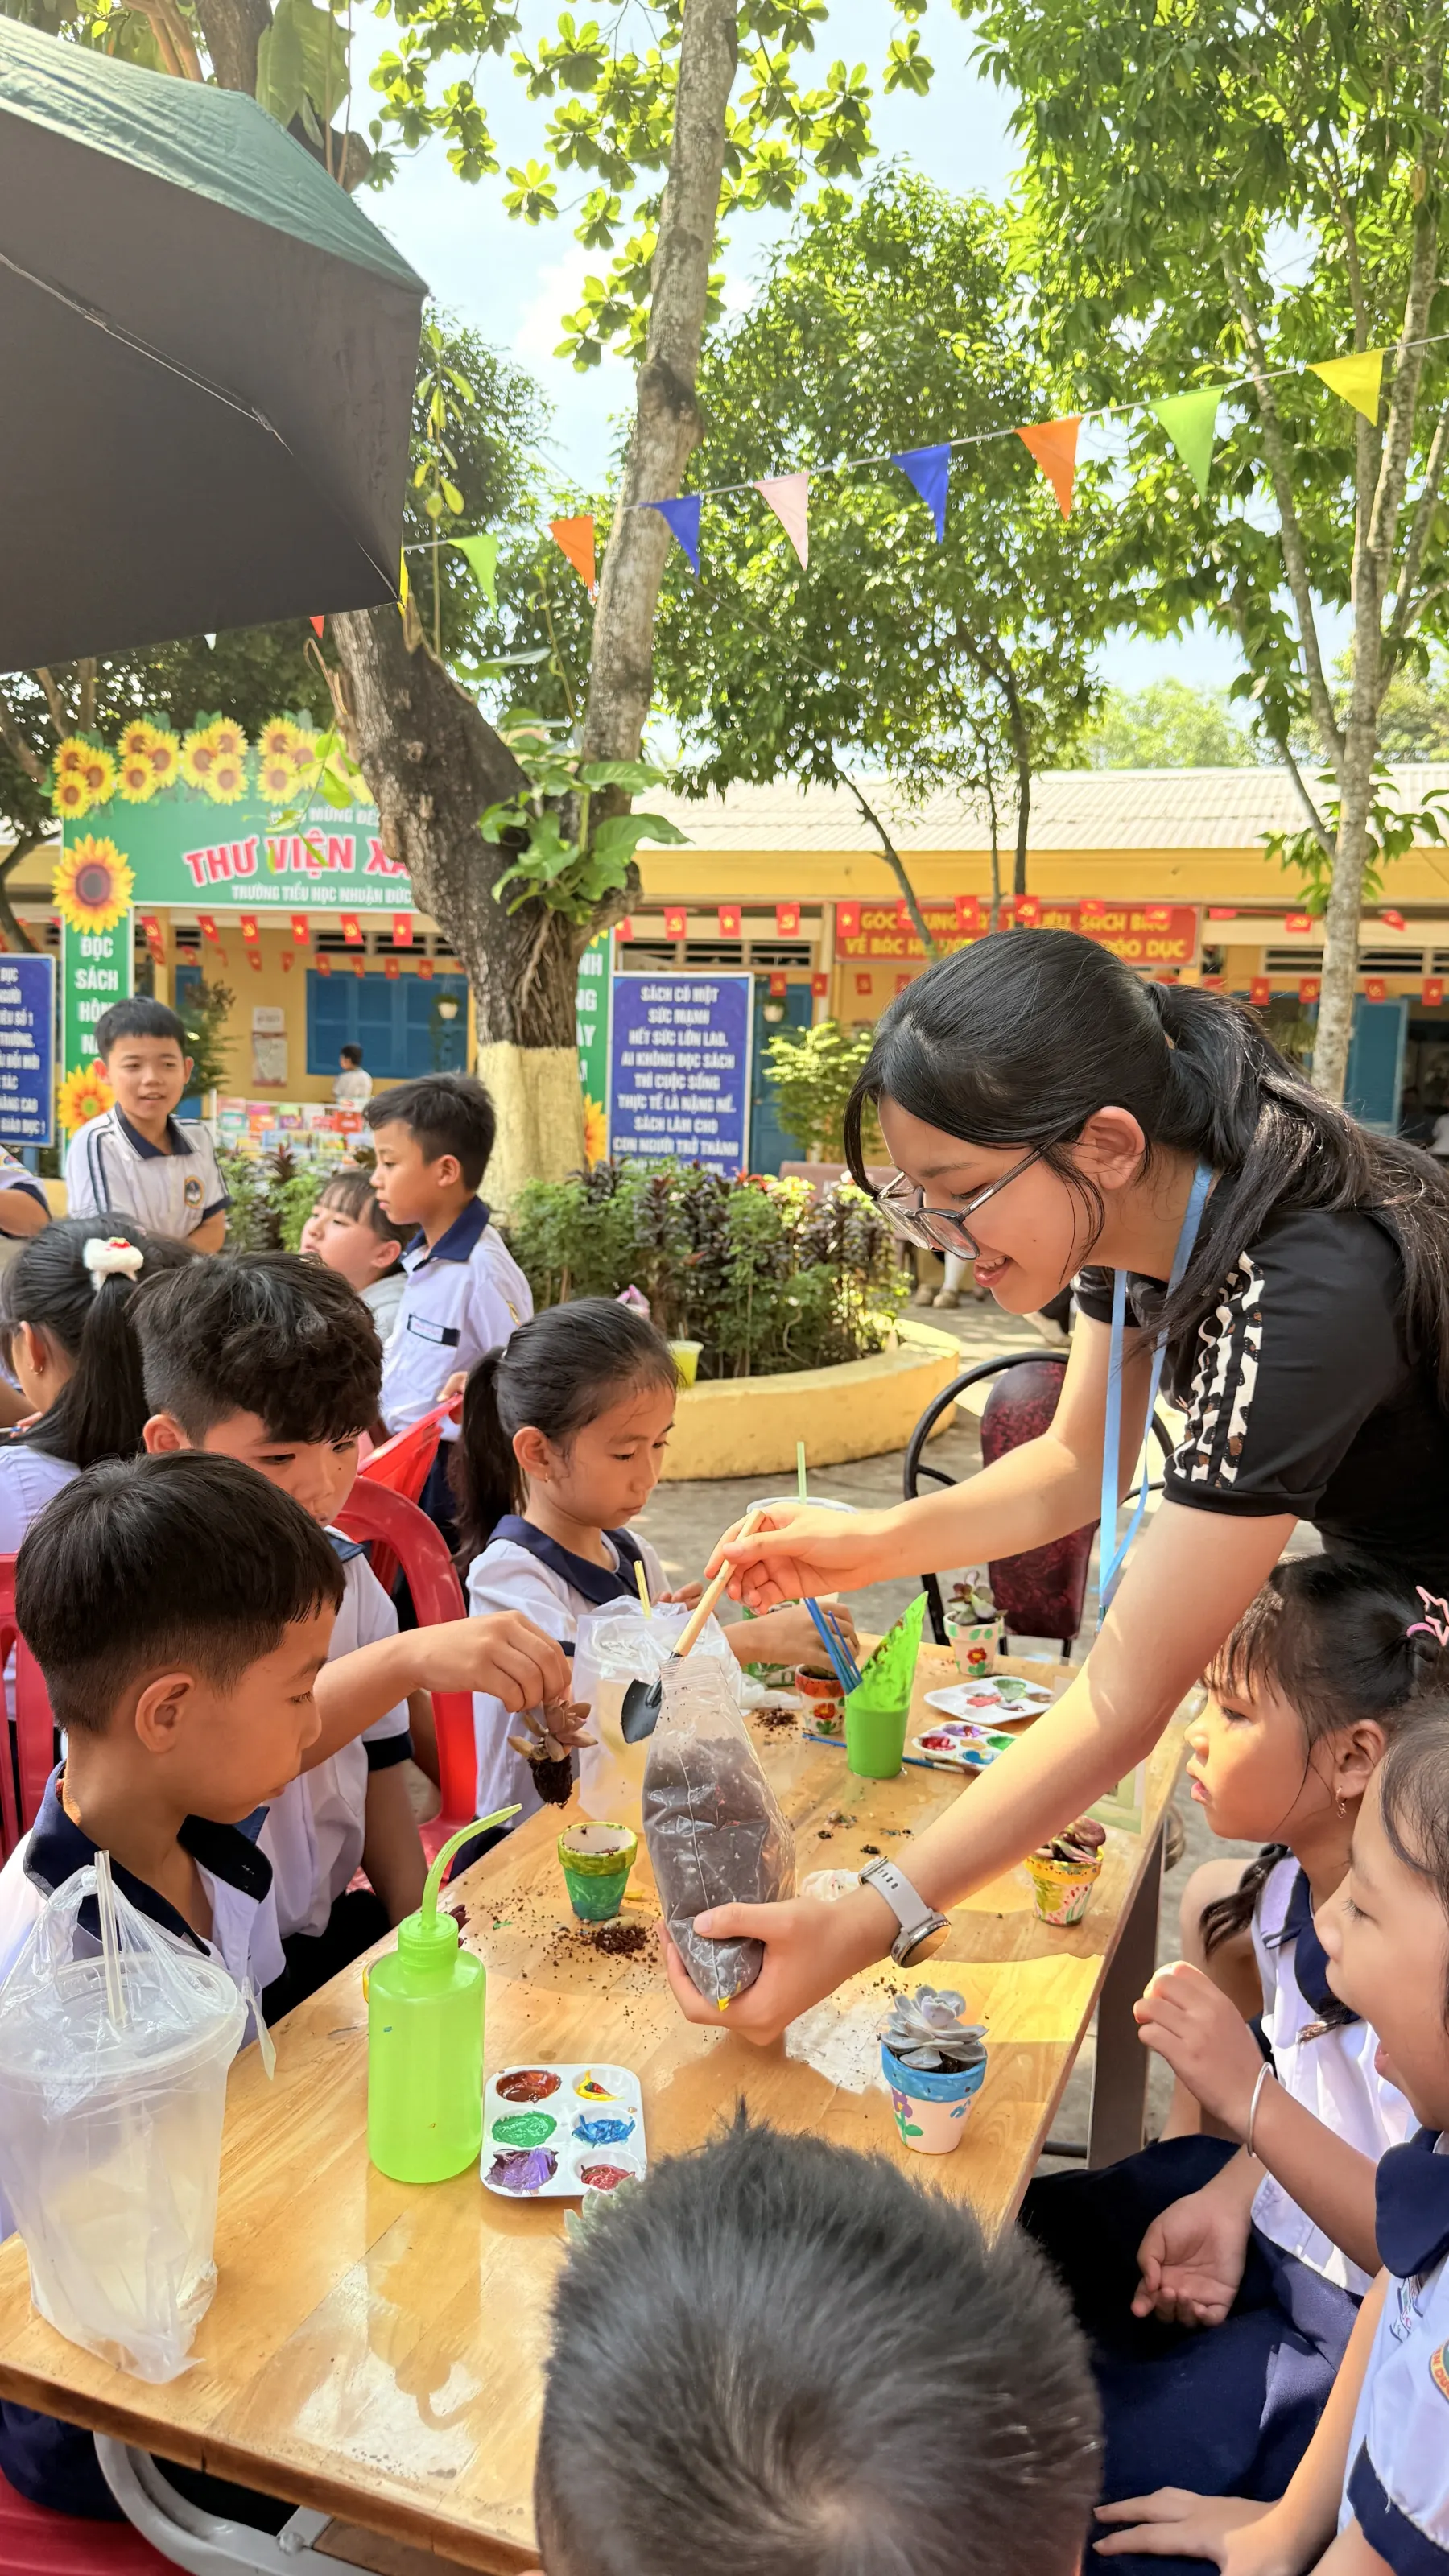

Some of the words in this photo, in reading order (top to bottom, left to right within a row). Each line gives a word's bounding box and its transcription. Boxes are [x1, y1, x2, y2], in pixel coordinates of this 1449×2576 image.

[184, 835, 259, 886] THƯ
[265, 828, 355, 879] VIỆN
[311, 888, 336, 905] HỌC
[80, 935, 114, 961] ĐỌC
[1146, 939, 1186, 960] DỤC
[74, 965, 119, 991] SÁCH
[641, 985, 672, 1002] SÁCH
[621, 1051, 634, 1067] AI
[694, 1117, 719, 1134] CHO
